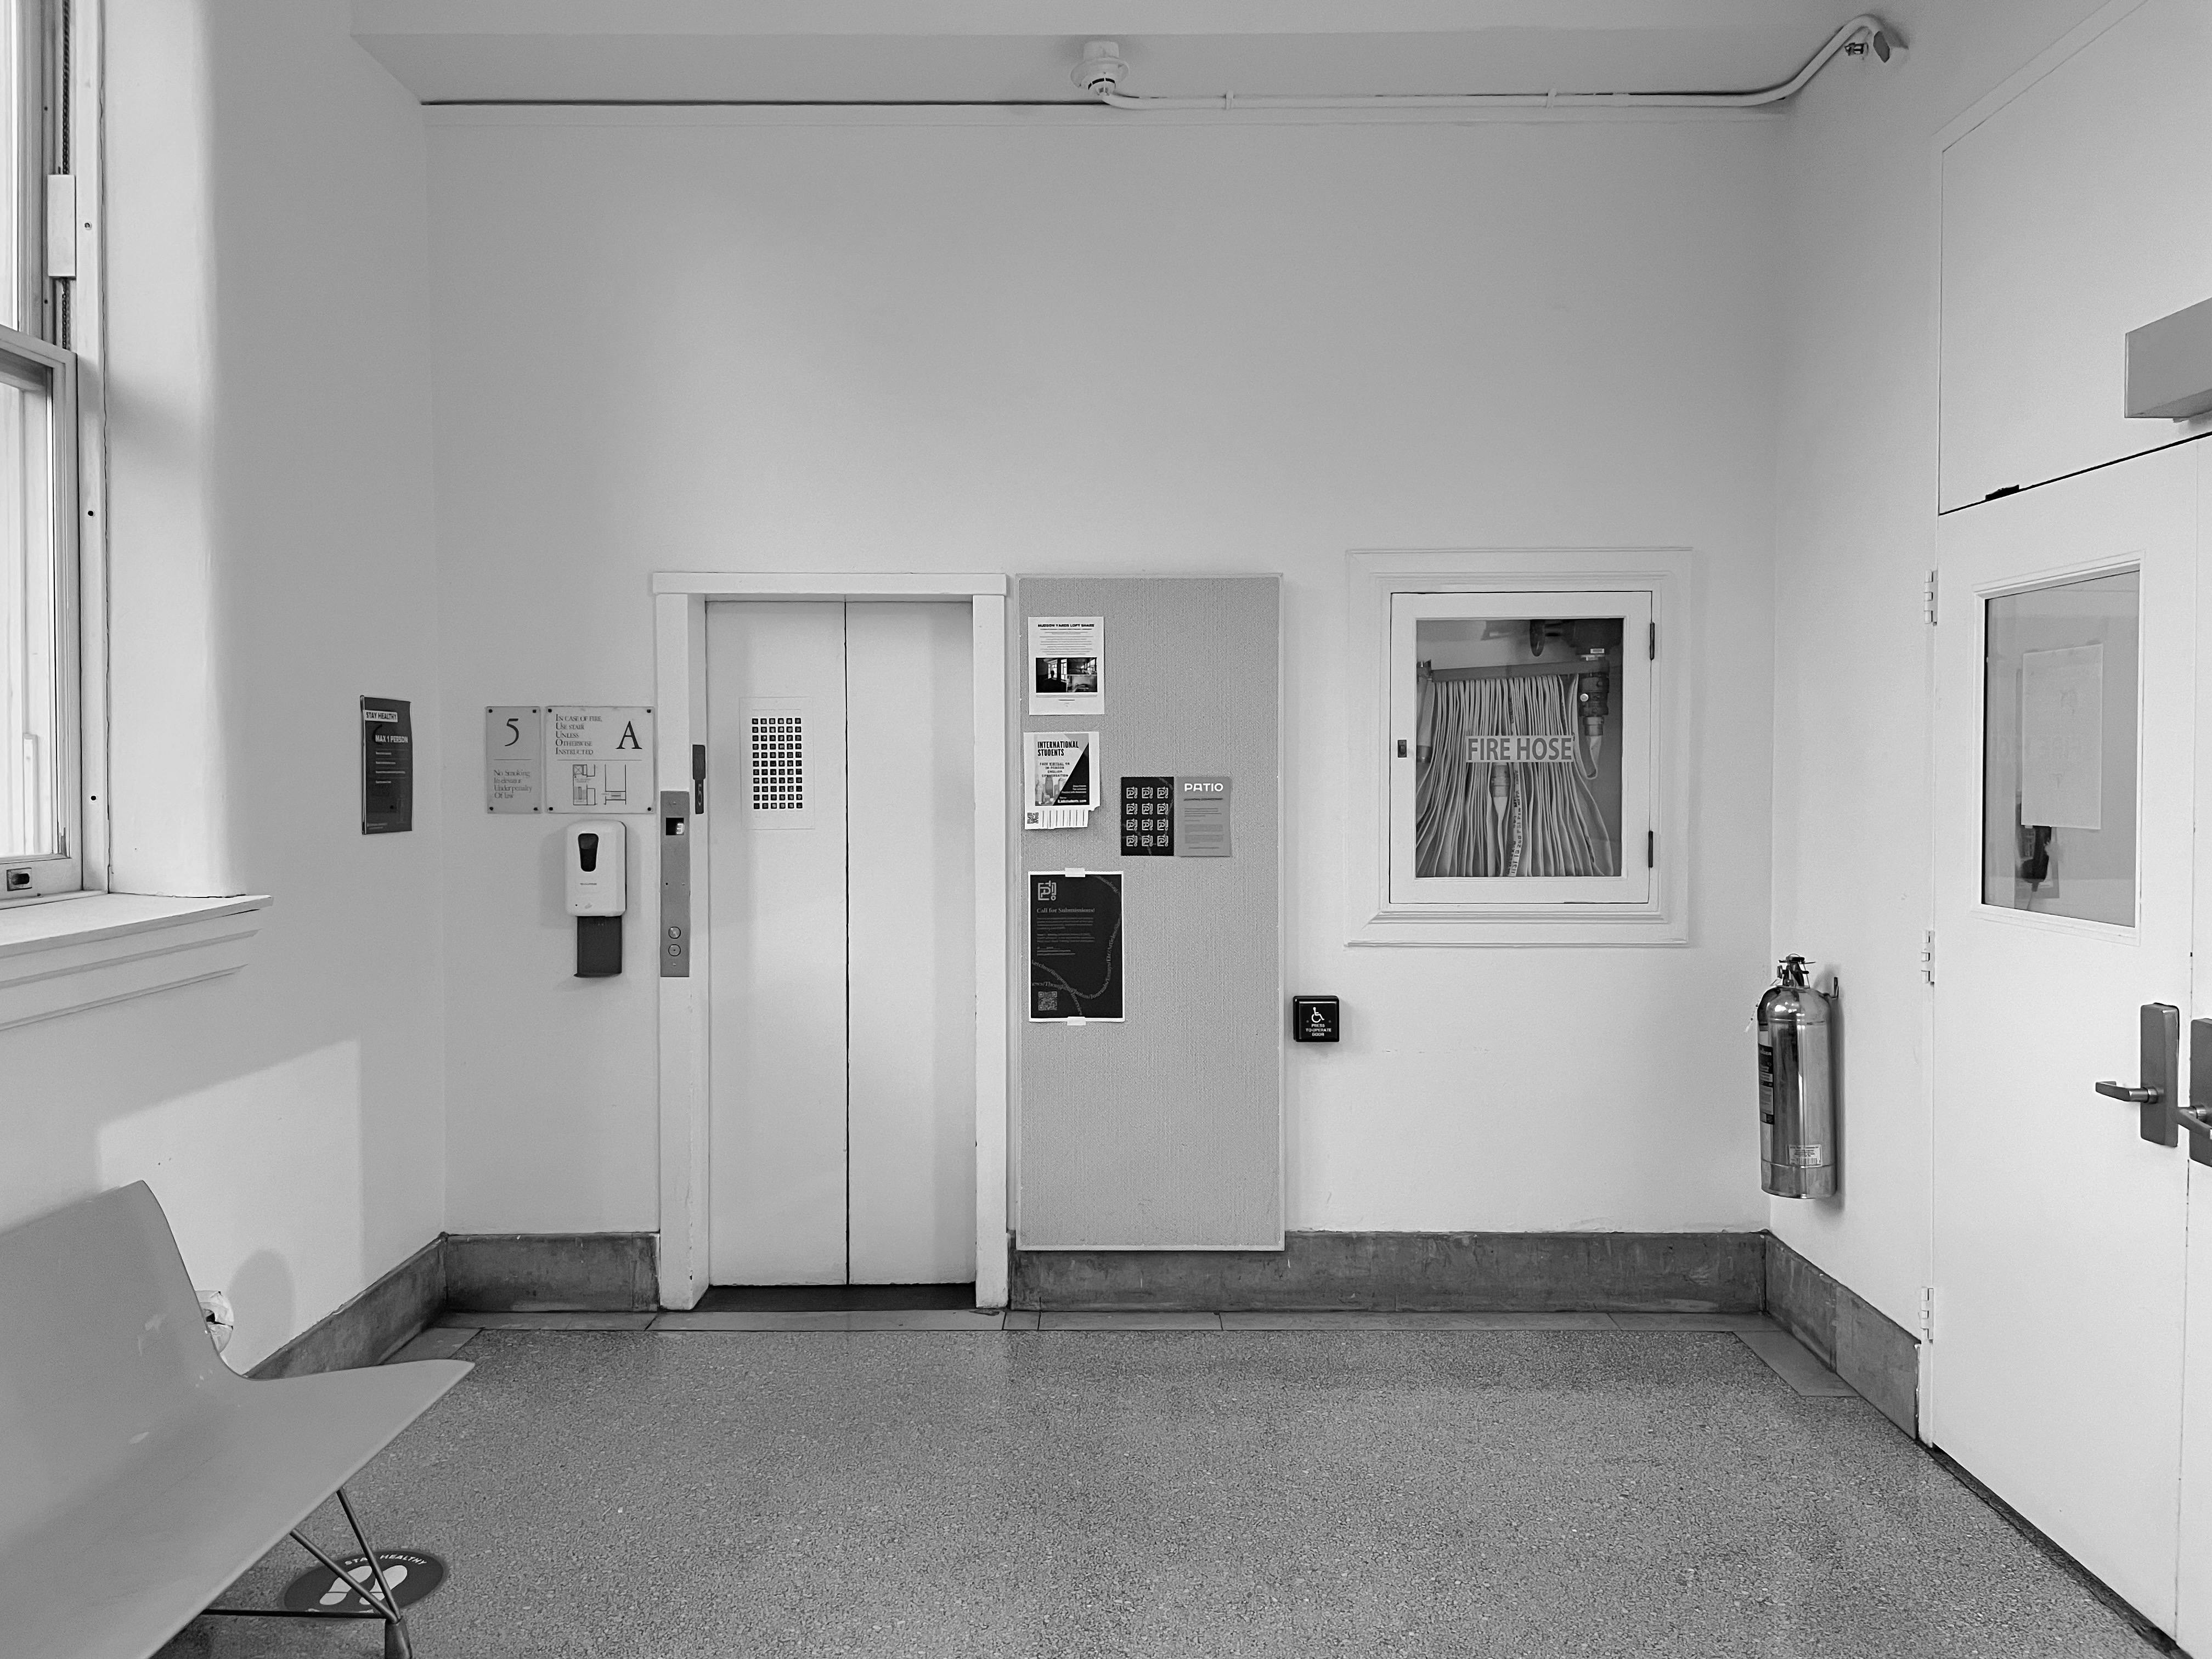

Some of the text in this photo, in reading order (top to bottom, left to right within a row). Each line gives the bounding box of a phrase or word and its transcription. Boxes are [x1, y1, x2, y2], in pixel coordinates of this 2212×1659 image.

[378, 712, 397, 720] HEALTHY
[505, 718, 519, 747] 5
[616, 720, 642, 749] A
[375, 735, 386, 743] MAX
[1468, 737, 1572, 760] FIRE HOSE
[1184, 783, 1223, 792] PATIO
[676, 823, 684, 834] 3
[380, 1554, 427, 1565] HEALTHY
